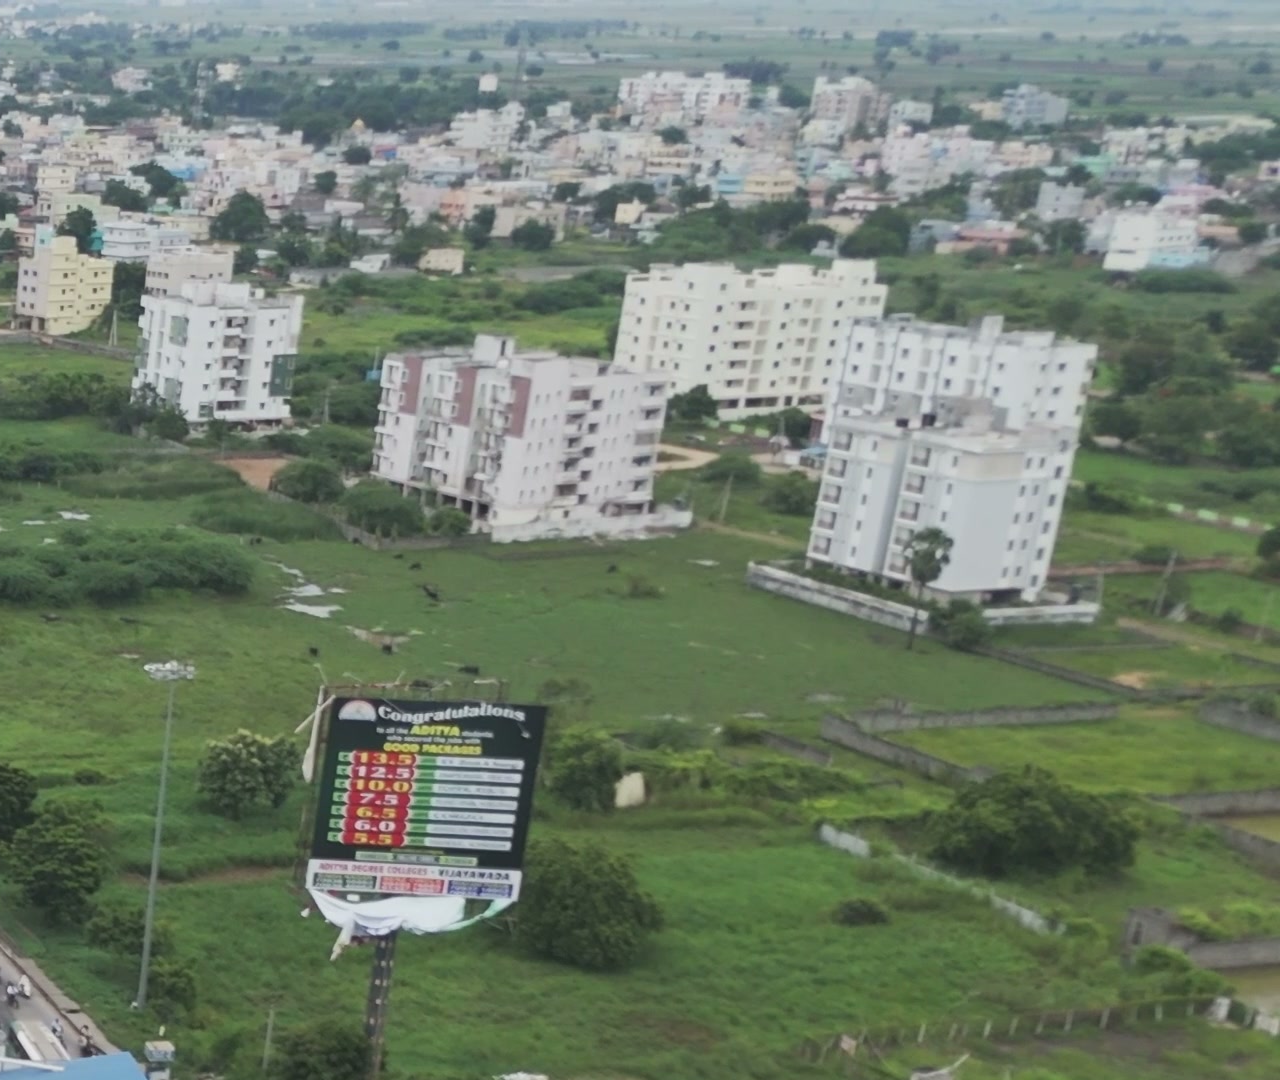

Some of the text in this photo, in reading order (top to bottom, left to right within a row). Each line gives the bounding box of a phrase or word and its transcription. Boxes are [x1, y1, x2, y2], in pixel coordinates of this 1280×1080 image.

[377, 702, 526, 725] Congratulations
[410, 724, 461, 738] ADITYA
[357, 752, 413, 766] 13.5
[355, 766, 411, 779] 12.5
[359, 794, 399, 806] 7.5
